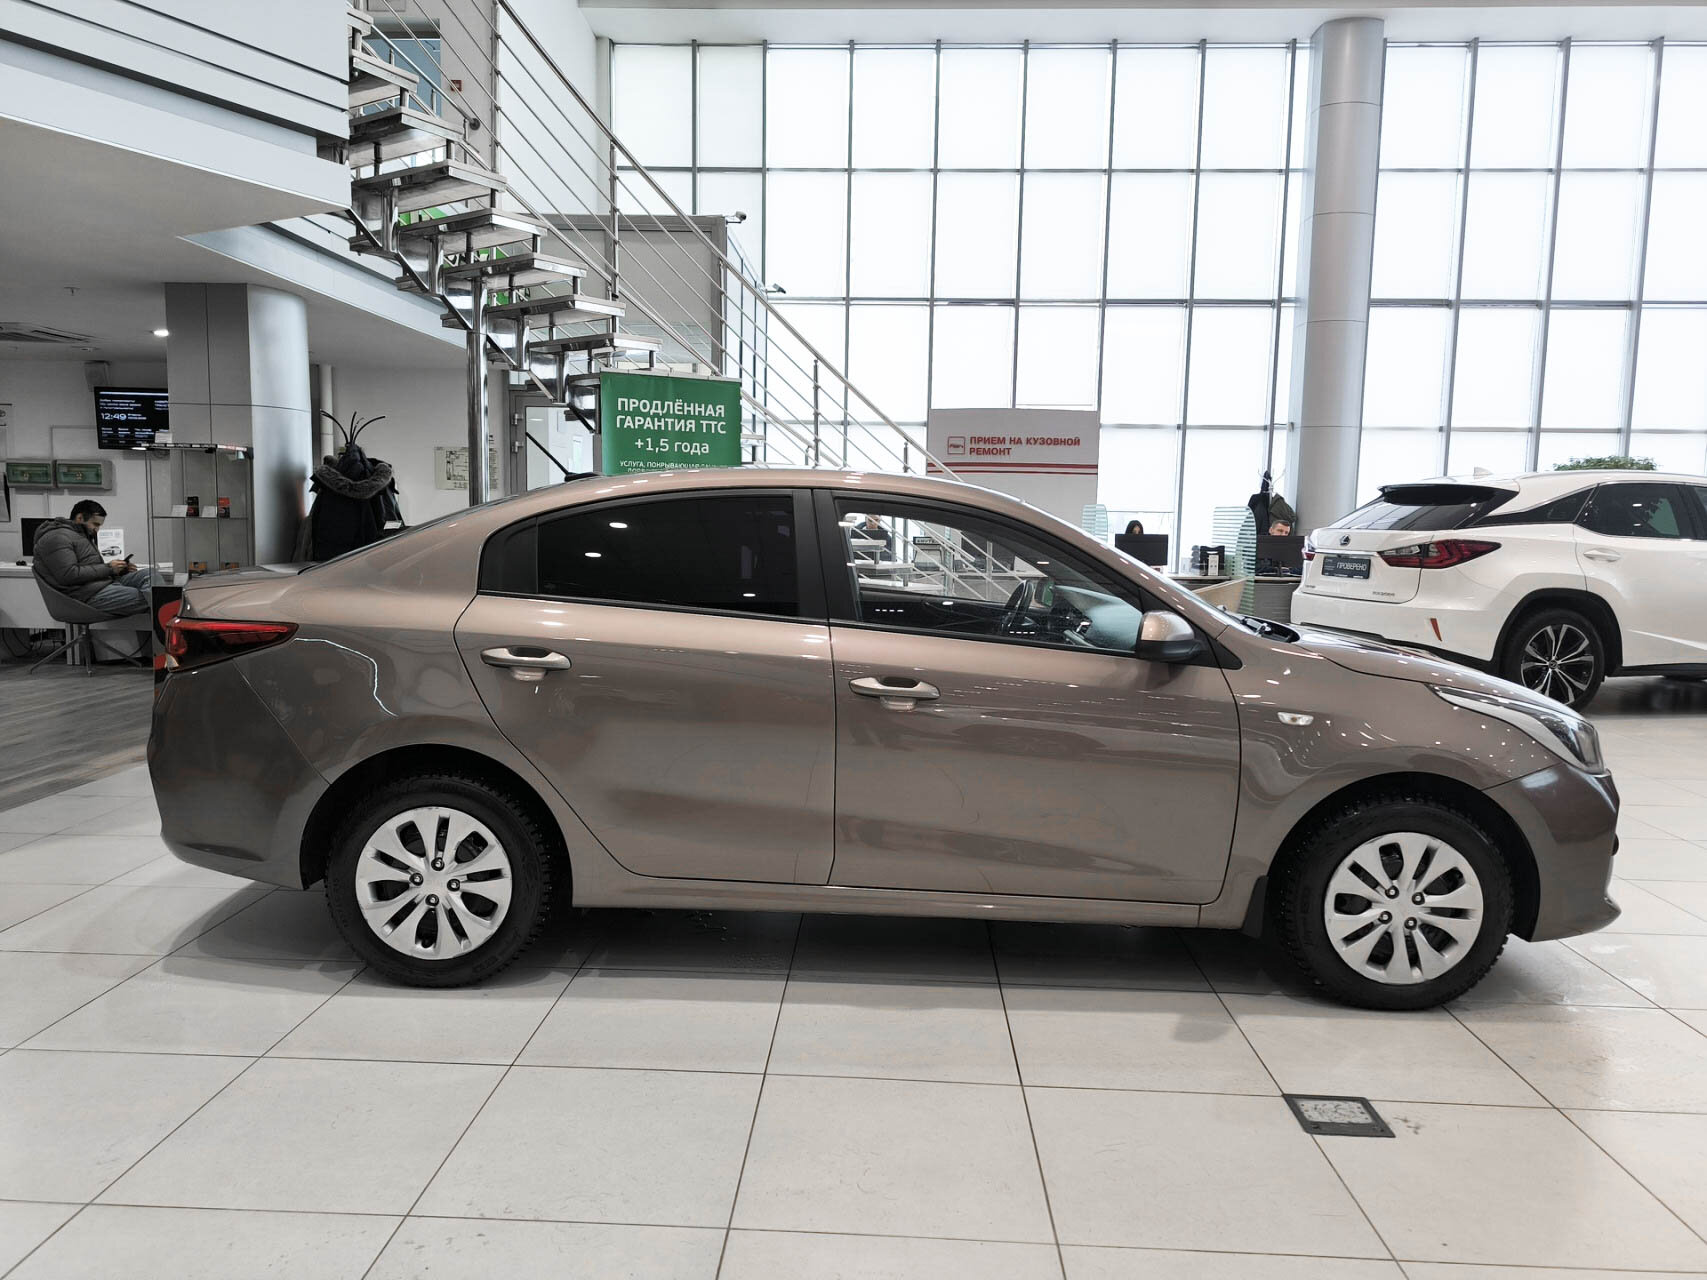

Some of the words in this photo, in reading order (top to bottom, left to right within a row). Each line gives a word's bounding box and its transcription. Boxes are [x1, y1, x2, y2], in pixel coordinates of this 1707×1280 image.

[617, 397, 725, 418] ПРОДЛЁННАЯ
[101, 413, 127, 421] 12:49
[616, 415, 696, 432] ГАРАНТИЯ
[700, 420, 727, 434] ТТС
[969, 436, 1006, 445] ПРИЕМ
[1009, 437, 1023, 445] НА
[1026, 436, 1081, 446] КУЗОВНОЙ
[635, 437, 669, 454] +1,5
[674, 441, 710, 456] года
[969, 447, 1012, 456] РЕМОНТ
[1336, 561, 1367, 571] ПРОВЕРЕНО
